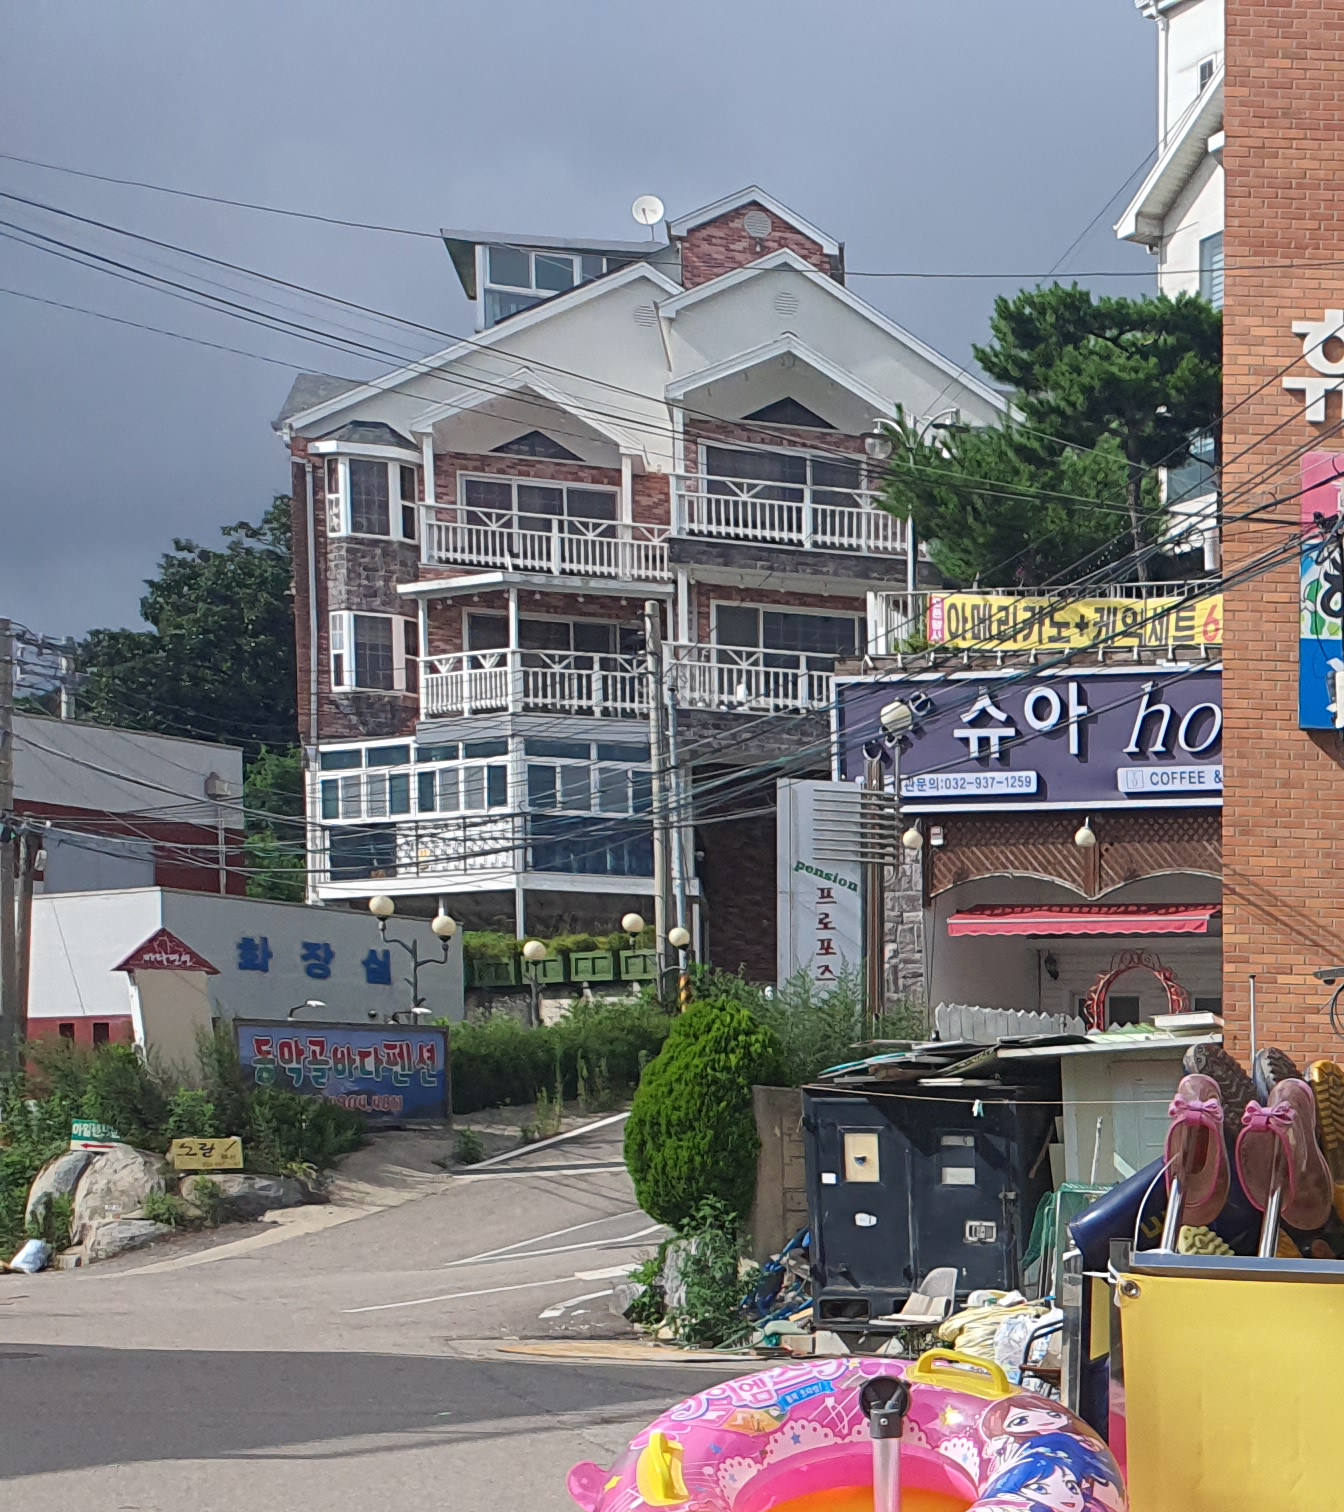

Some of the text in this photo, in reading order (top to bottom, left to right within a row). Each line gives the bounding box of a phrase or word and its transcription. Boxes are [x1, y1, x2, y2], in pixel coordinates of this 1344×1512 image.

[953, 681, 1087, 758] 슈아
[1150, 771, 1205, 786] COFFEE
[794, 861, 858, 892] pension
[237, 936, 392, 985] 화장실
